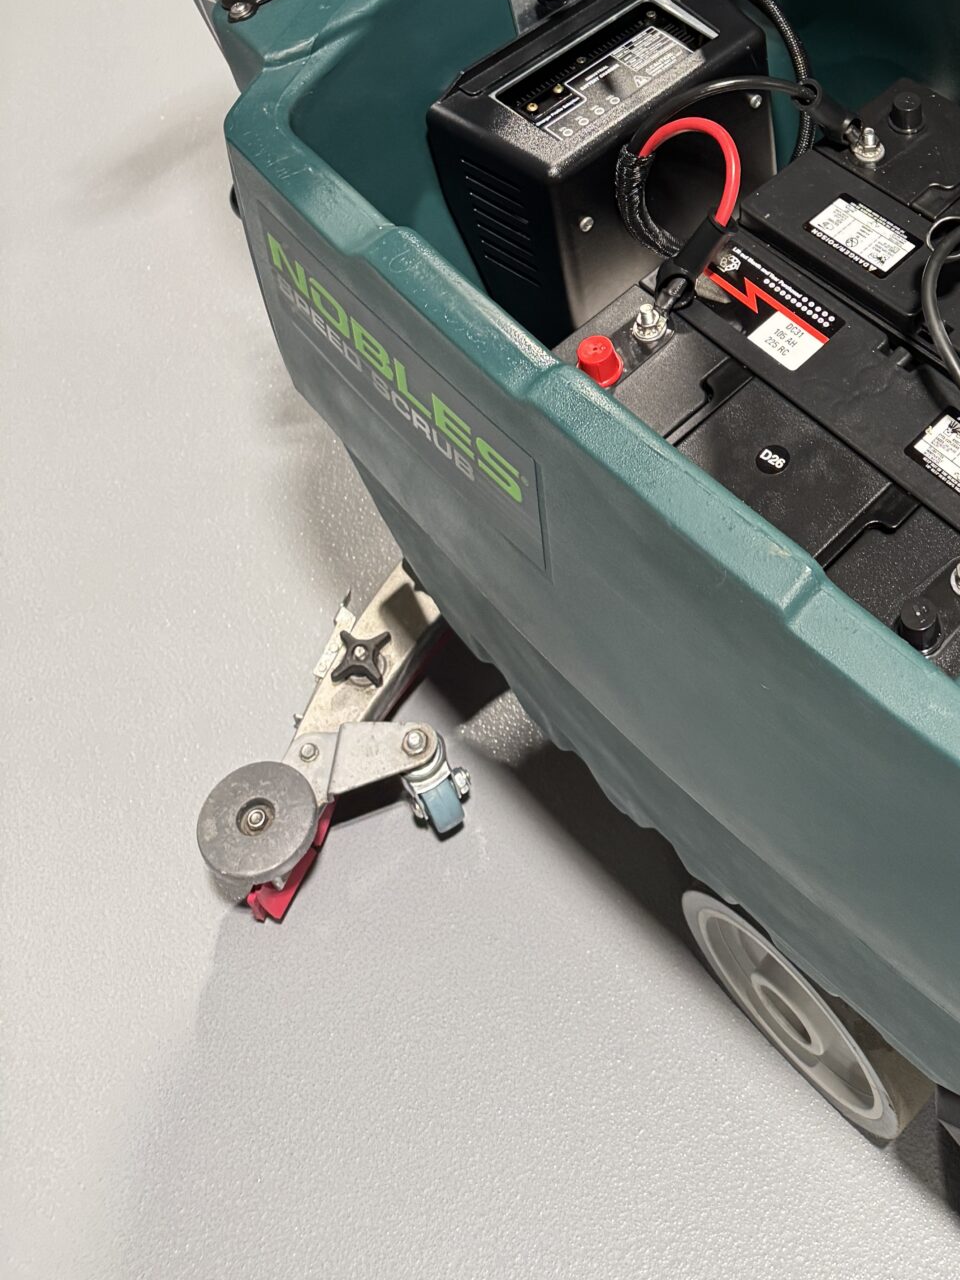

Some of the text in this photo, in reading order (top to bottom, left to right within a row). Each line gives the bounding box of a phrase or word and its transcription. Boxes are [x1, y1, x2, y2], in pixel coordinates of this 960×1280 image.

[810, 228, 870, 269] DANGER/POISON
[773, 328, 798, 348] 105 AH
[785, 323, 805, 338] DC31
[764, 336, 790, 357] 225 RC
[267, 232, 523, 503] NOBLES
[278, 276, 475, 482] SPEED SCRUB
[759, 448, 786, 469] D26
